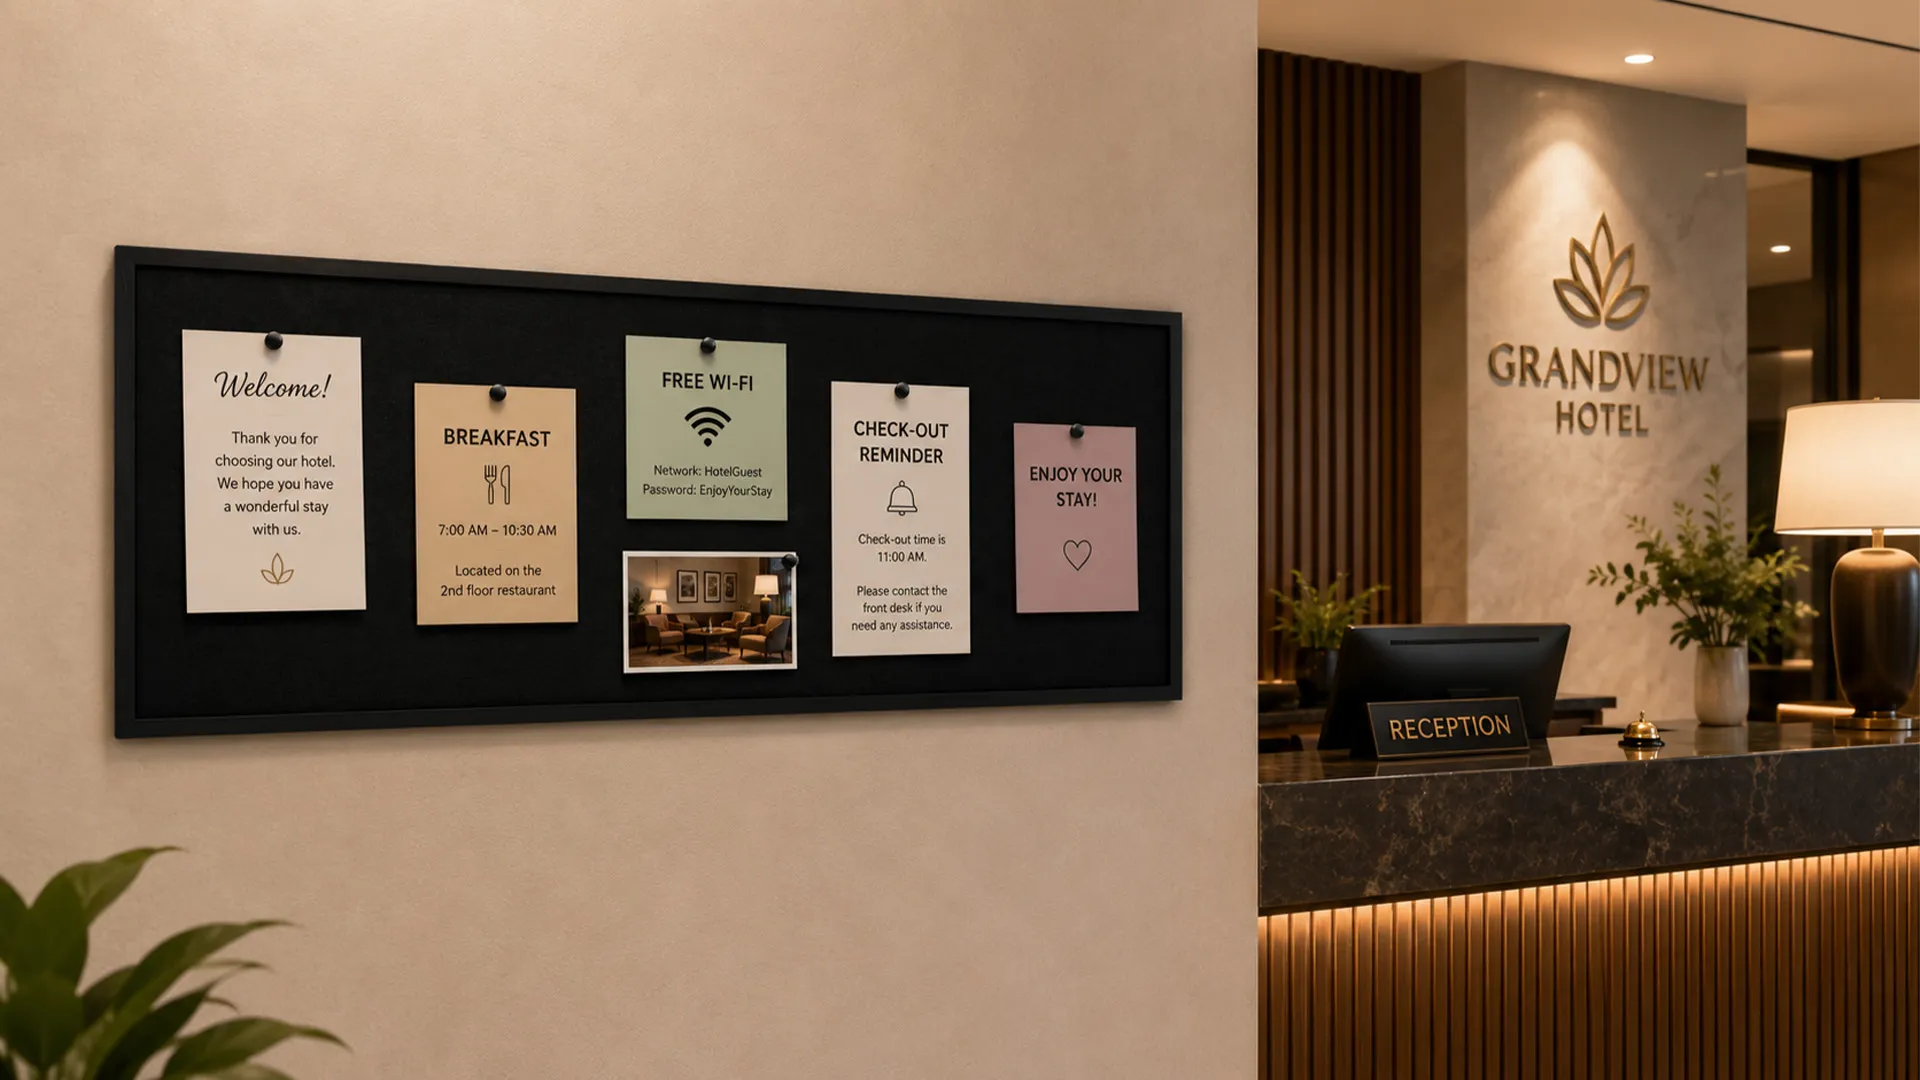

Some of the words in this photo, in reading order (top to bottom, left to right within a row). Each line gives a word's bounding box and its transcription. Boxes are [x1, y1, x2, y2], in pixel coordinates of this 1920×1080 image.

[1488, 343, 1710, 392] GRANDVIEW
[214, 371, 331, 398] Welcome!
[663, 372, 704, 389] FREE
[709, 374, 752, 391] WI-FI
[1557, 401, 1649, 437] HOTEL
[854, 421, 948, 438] CHECK-OUT
[232, 431, 270, 444] Thank
[274, 435, 296, 447] you
[301, 432, 318, 445] for
[444, 428, 550, 447] BREAKFAST
[216, 454, 272, 470] choosing
[277, 458, 297, 467] our
[302, 455, 335, 467] hotel.
[860, 447, 943, 463] REMINDER
[654, 465, 701, 476] Network:
[705, 466, 762, 477] HotelGuest
[1030, 467, 1077, 481] ENJOY
[1082, 468, 1122, 482] YOUR
[217, 477, 238, 489] We
[242, 477, 274, 492] hope
[277, 480, 301, 492] you
[304, 478, 333, 489] have
[643, 484, 696, 495] Password:
[700, 484, 772, 499] EnjoyYourStay
[1057, 492, 1096, 506] STAY!
[224, 503, 231, 512] a
[235, 500, 299, 512] wonderful
[303, 502, 328, 515] stay
[253, 523, 279, 535] with
[284, 526, 301, 535] us.
[439, 524, 464, 535] 7:00
[468, 524, 487, 535] AM
[503, 524, 534, 536] 10:30
[537, 525, 556, 536] AM
[858, 534, 911, 544] Check-out
[914, 534, 935, 544] time
[938, 534, 945, 544] is
[878, 551, 905, 562] 11:00
[908, 552, 926, 561] AM.
[456, 564, 501, 576] Located
[505, 568, 519, 576] on
[523, 564, 541, 576] the
[441, 585, 463, 596] 2nd
[467, 584, 494, 596] floor
[498, 586, 556, 595] restaurant
[857, 586, 889, 596] Please
[892, 587, 929, 596] contact
[932, 585, 947, 595] the
[863, 603, 887, 613] front
[890, 603, 912, 613] desk
[916, 602, 922, 612] if
[924, 605, 942, 615] you
[852, 620, 876, 630] need
[880, 622, 897, 632] any
[900, 620, 952, 630] assistance.
[1389, 715, 1510, 740] RECEPTION
